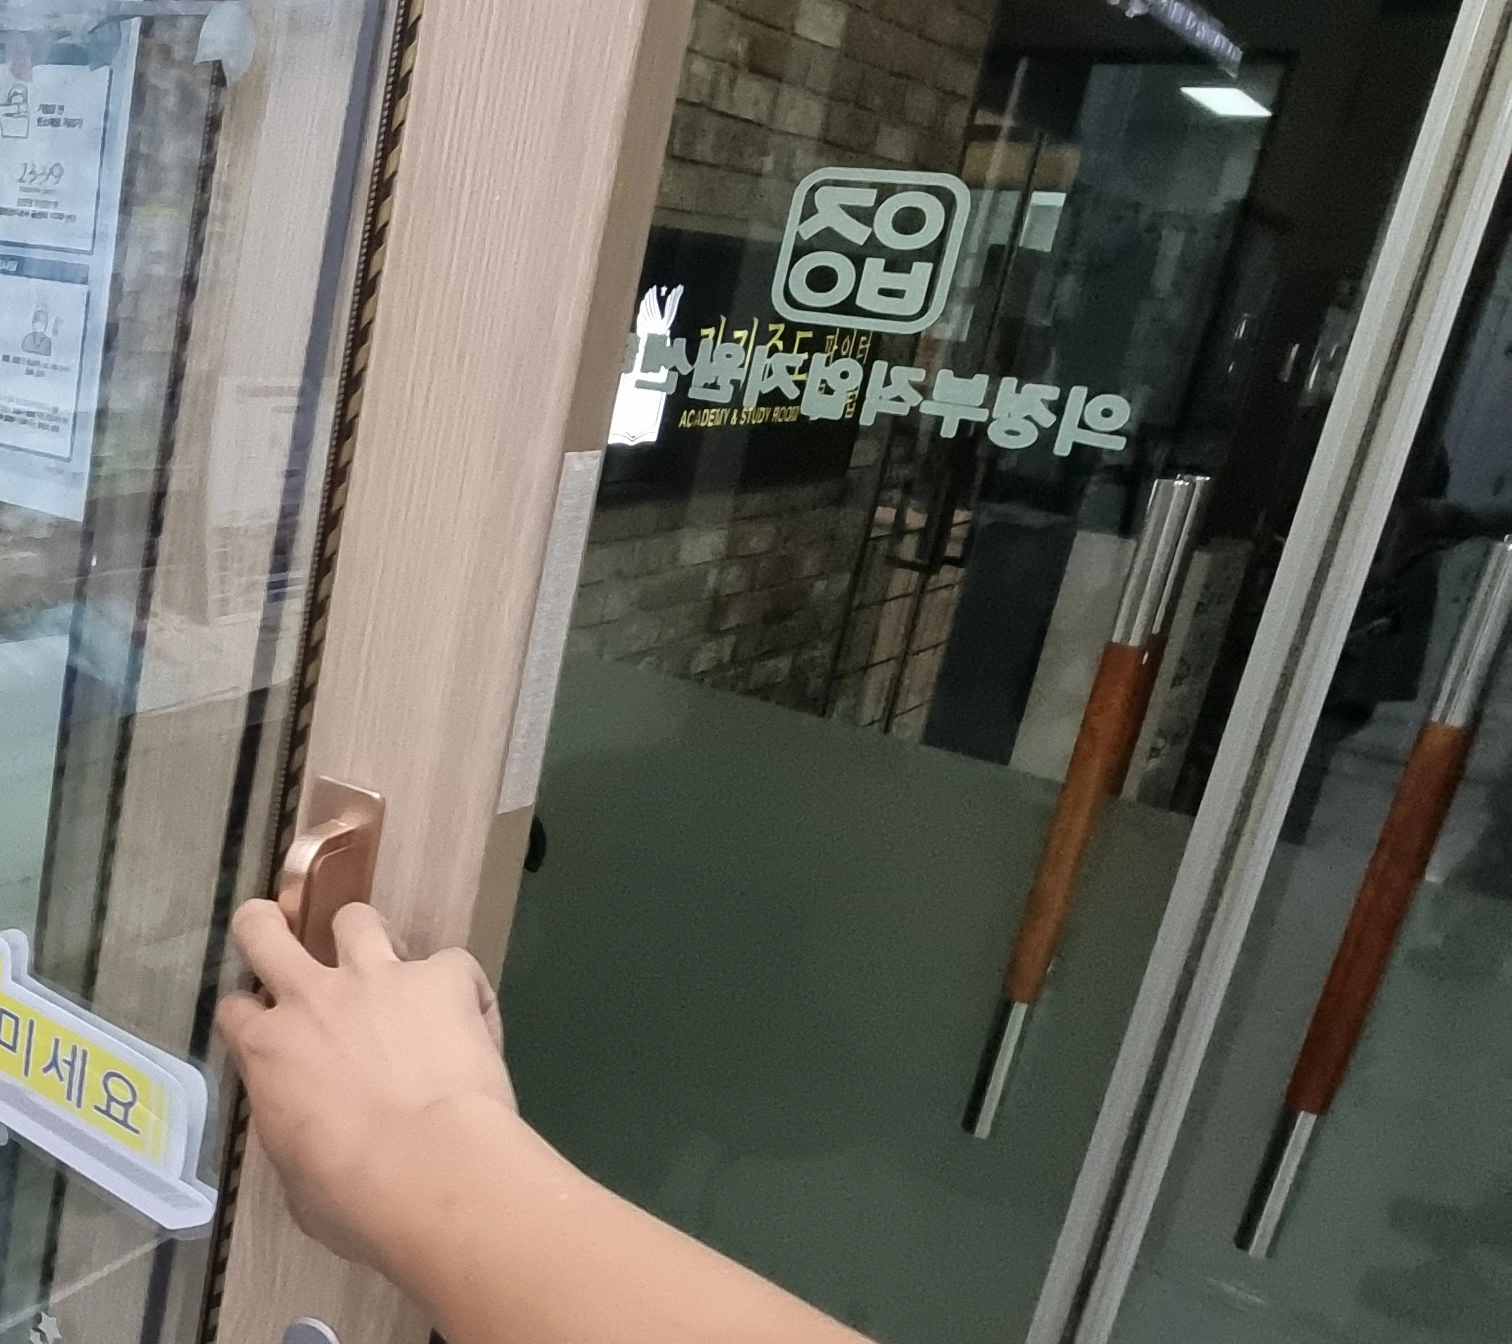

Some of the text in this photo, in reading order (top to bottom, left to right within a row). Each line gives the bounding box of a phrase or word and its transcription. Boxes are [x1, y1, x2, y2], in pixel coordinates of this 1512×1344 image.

[678, 405, 801, 428] ACADEMY & STUDY ROOM
